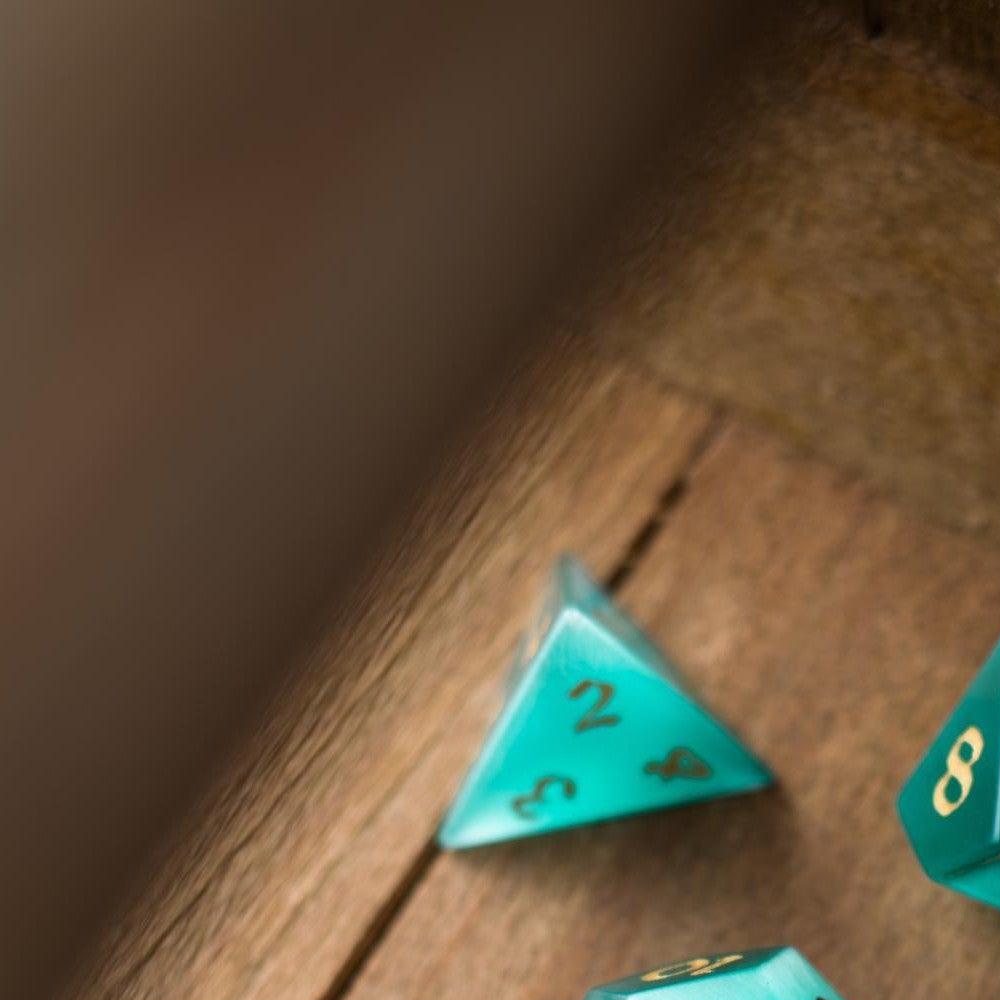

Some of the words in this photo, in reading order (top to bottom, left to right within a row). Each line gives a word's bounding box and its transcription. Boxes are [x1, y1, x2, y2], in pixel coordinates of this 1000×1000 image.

[568, 678, 622, 734] 2
[511, 774, 577, 821] 3
[932, 725, 985, 818] 8
